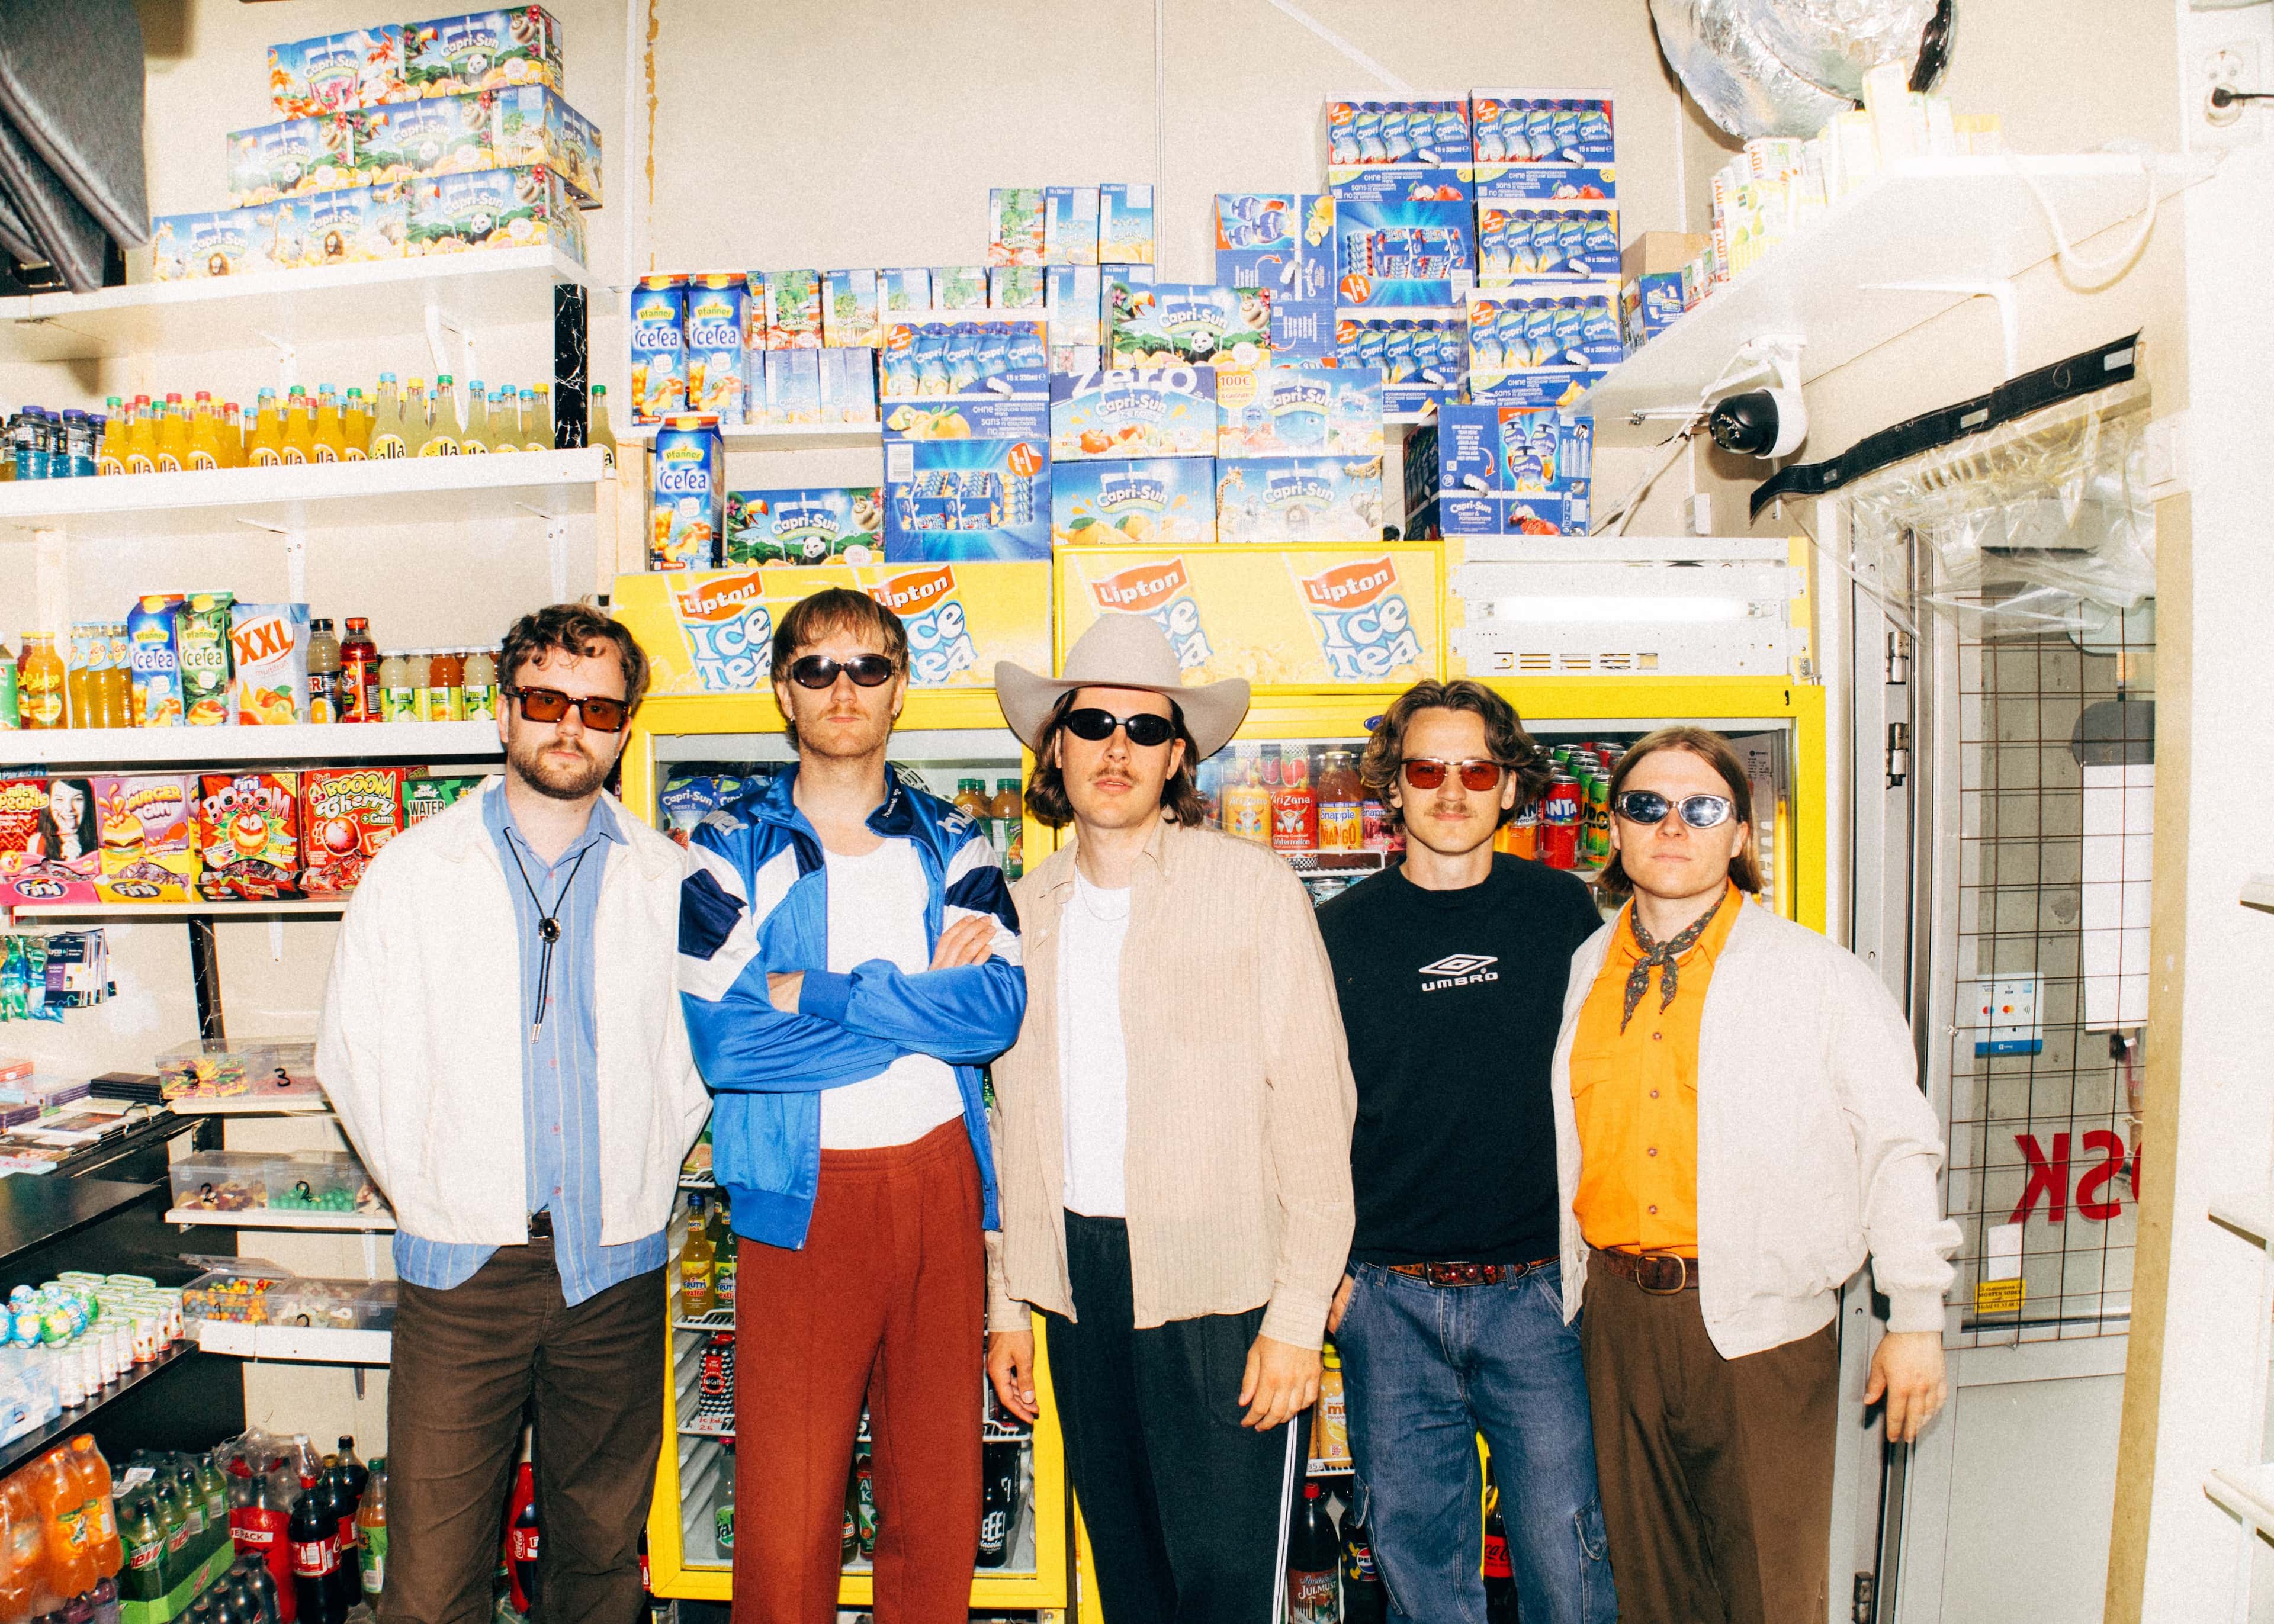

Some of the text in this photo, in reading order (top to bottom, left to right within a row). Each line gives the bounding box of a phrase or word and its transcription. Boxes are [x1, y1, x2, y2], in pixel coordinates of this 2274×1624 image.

[441, 32, 500, 57] Capri-Sun
[445, 193, 503, 215] Capri-Sun
[1158, 307, 1227, 328] Capri-Sun
[1096, 393, 1167, 416] Capri-Sun
[1263, 385, 1334, 410] Capri-Sun
[1097, 483, 1168, 507] Capri-Sun
[1263, 482, 1335, 506] Capri-Sun
[1450, 501, 1492, 514] Capri-Sun
[770, 512, 840, 535] Capri-Sun
[875, 574, 949, 609] Lipton
[1100, 570, 1180, 604] Lipton
[1309, 567, 1389, 602] Lipton
[683, 580, 757, 615] Lipton
[233, 619, 294, 666] XXL
[323, 772, 395, 799] BOOOM
[129, 786, 182, 811] BURGER
[143, 801, 172, 819] GUM
[203, 786, 290, 825] BOOOM
[316, 795, 396, 819] Cherry
[663, 791, 713, 806] Capri-Sun
[370, 813, 394, 824] Gum
[1320, 809, 1355, 821] Snapple
[1320, 824, 1356, 845] MANGO
[20, 880, 63, 896] Fini
[115, 881, 157, 897] Fini
[1422, 972, 1499, 991] UMBRO
[274, 1067, 291, 1087] 3
[1298, 1581, 1337, 1600] JULMUST
